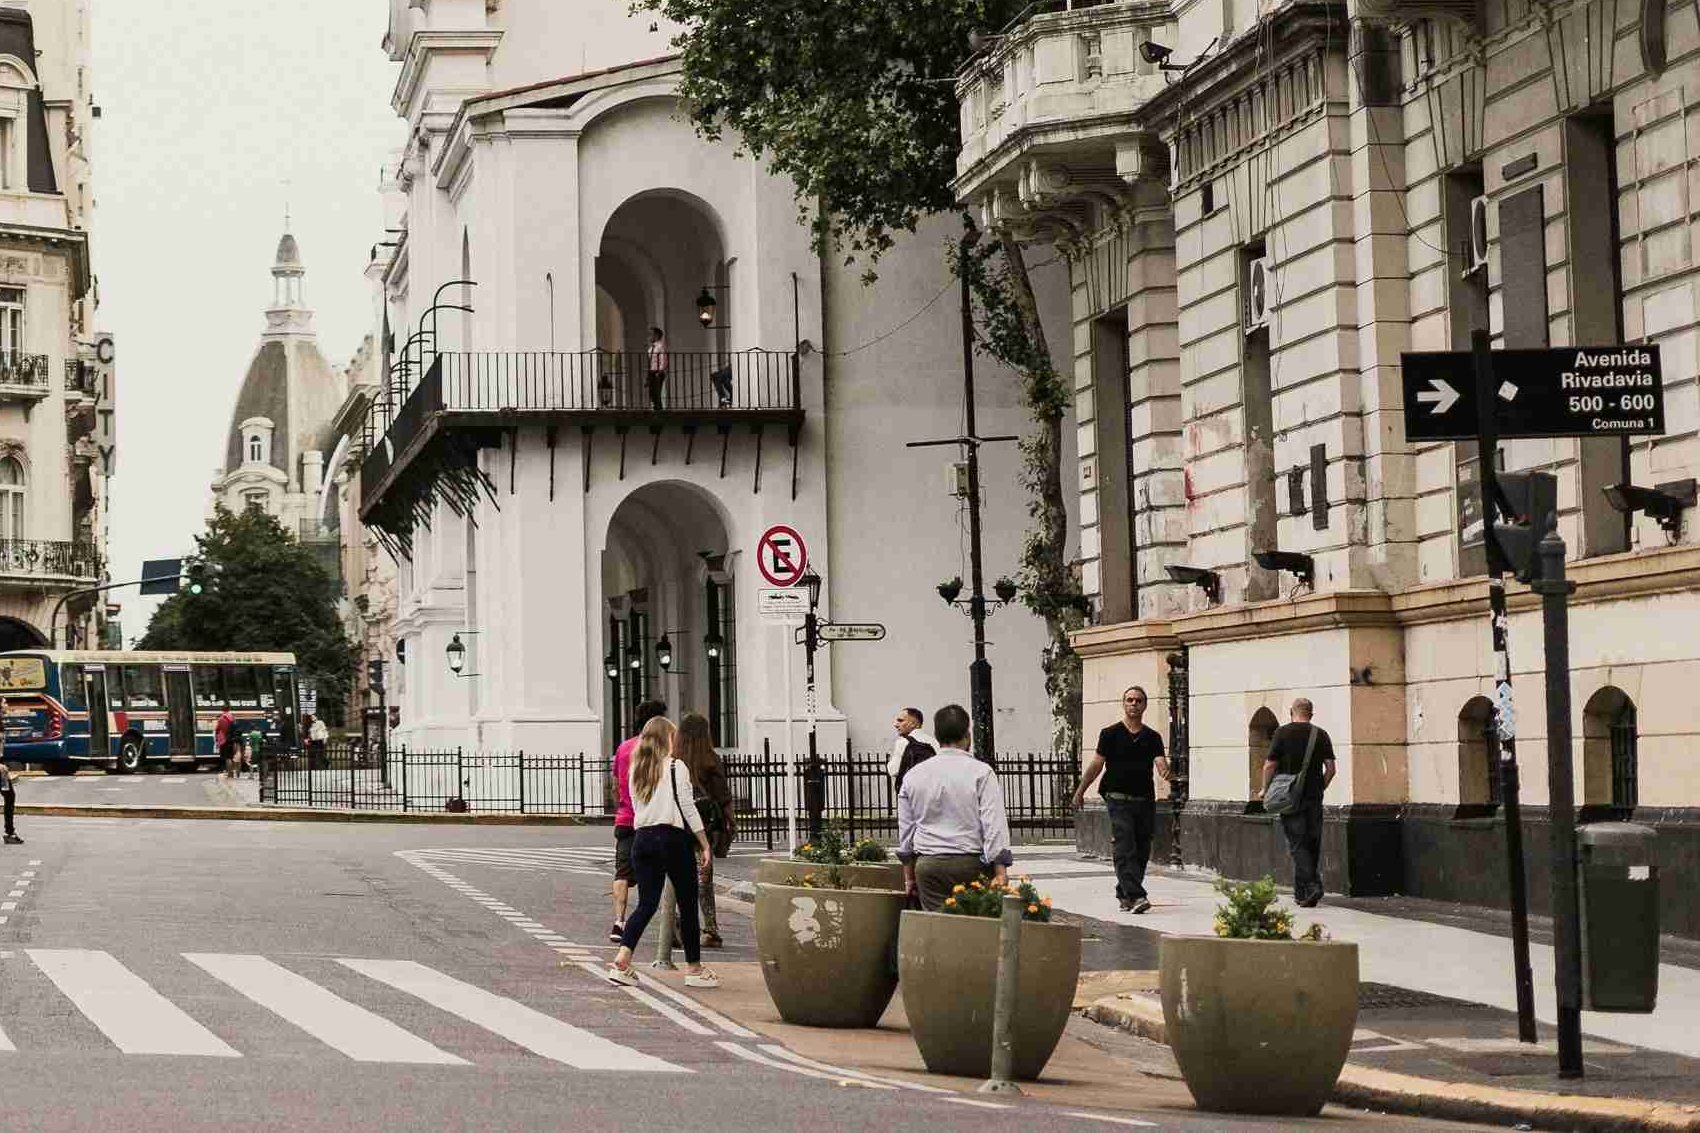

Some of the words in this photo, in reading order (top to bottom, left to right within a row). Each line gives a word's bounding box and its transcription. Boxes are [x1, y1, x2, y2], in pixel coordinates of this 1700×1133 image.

[1574, 350, 1651, 367] Avenida
[1561, 372, 1653, 388] Rivadavia
[1569, 395, 1603, 412] 500
[1620, 394, 1655, 410] 600
[1592, 418, 1644, 429] Comuna
[1648, 418, 1654, 428] 1
[772, 539, 791, 573] E
